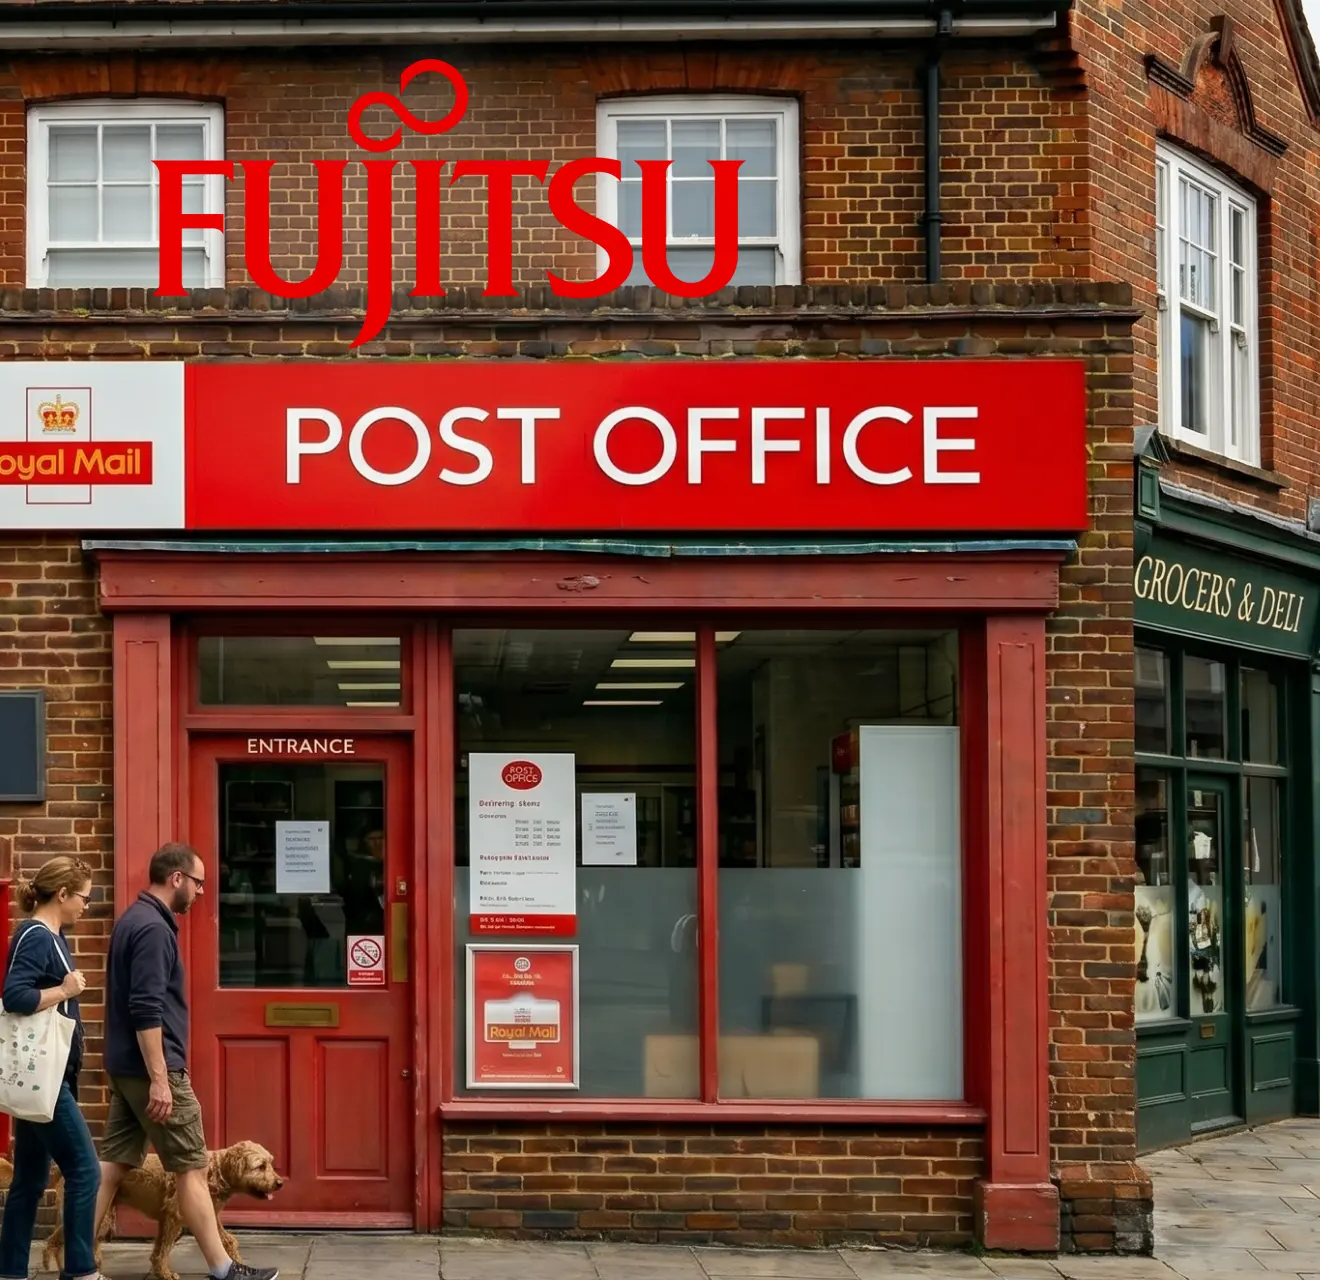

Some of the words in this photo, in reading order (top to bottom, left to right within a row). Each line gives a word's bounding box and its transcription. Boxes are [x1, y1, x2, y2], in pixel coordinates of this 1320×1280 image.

[285, 406, 561, 486] POST
[593, 405, 981, 486] OFFICE
[73, 448, 141, 475] Mail
[1134, 555, 1236, 618] GROCERS
[1237, 582, 1255, 622] &
[1256, 586, 1305, 633] DELI
[247, 738, 355, 754] ENTRANCE
[490, 1026, 526, 1039] Royal
